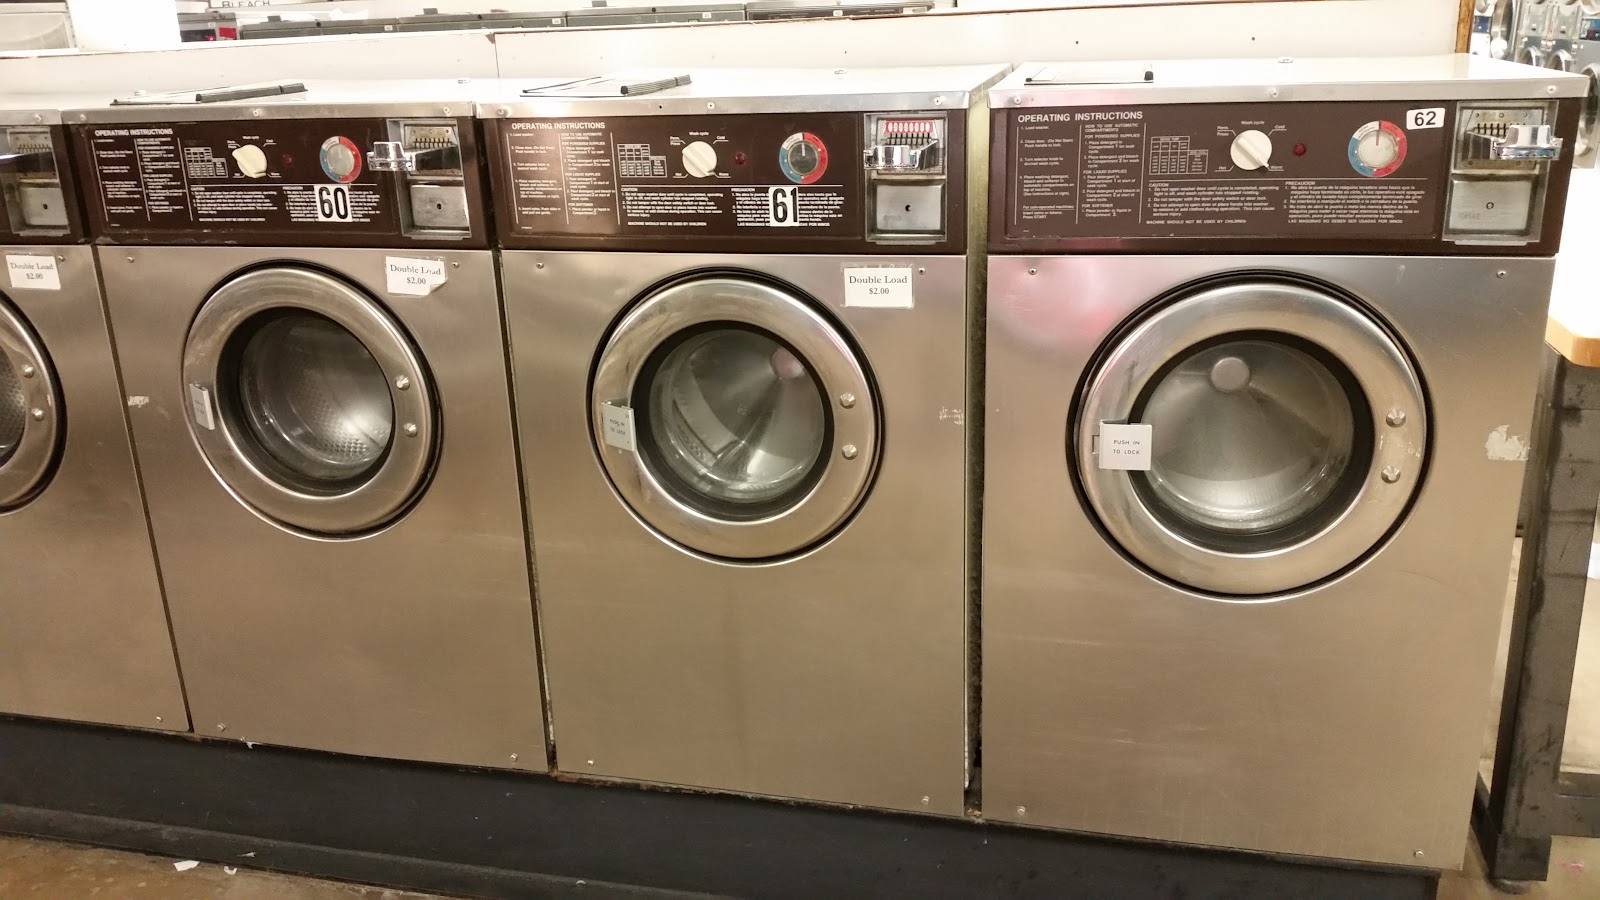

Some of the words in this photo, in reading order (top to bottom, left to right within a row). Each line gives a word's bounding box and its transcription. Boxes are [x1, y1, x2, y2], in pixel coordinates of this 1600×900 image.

[1018, 113, 1070, 122] OPERATING
[1075, 111, 1143, 121] INSTRUCTIONS
[1414, 111, 1436, 126] 62
[318, 186, 348, 220] 60
[772, 188, 798, 223] 61
[390, 264, 419, 274] Double
[421, 266, 441, 275] Load
